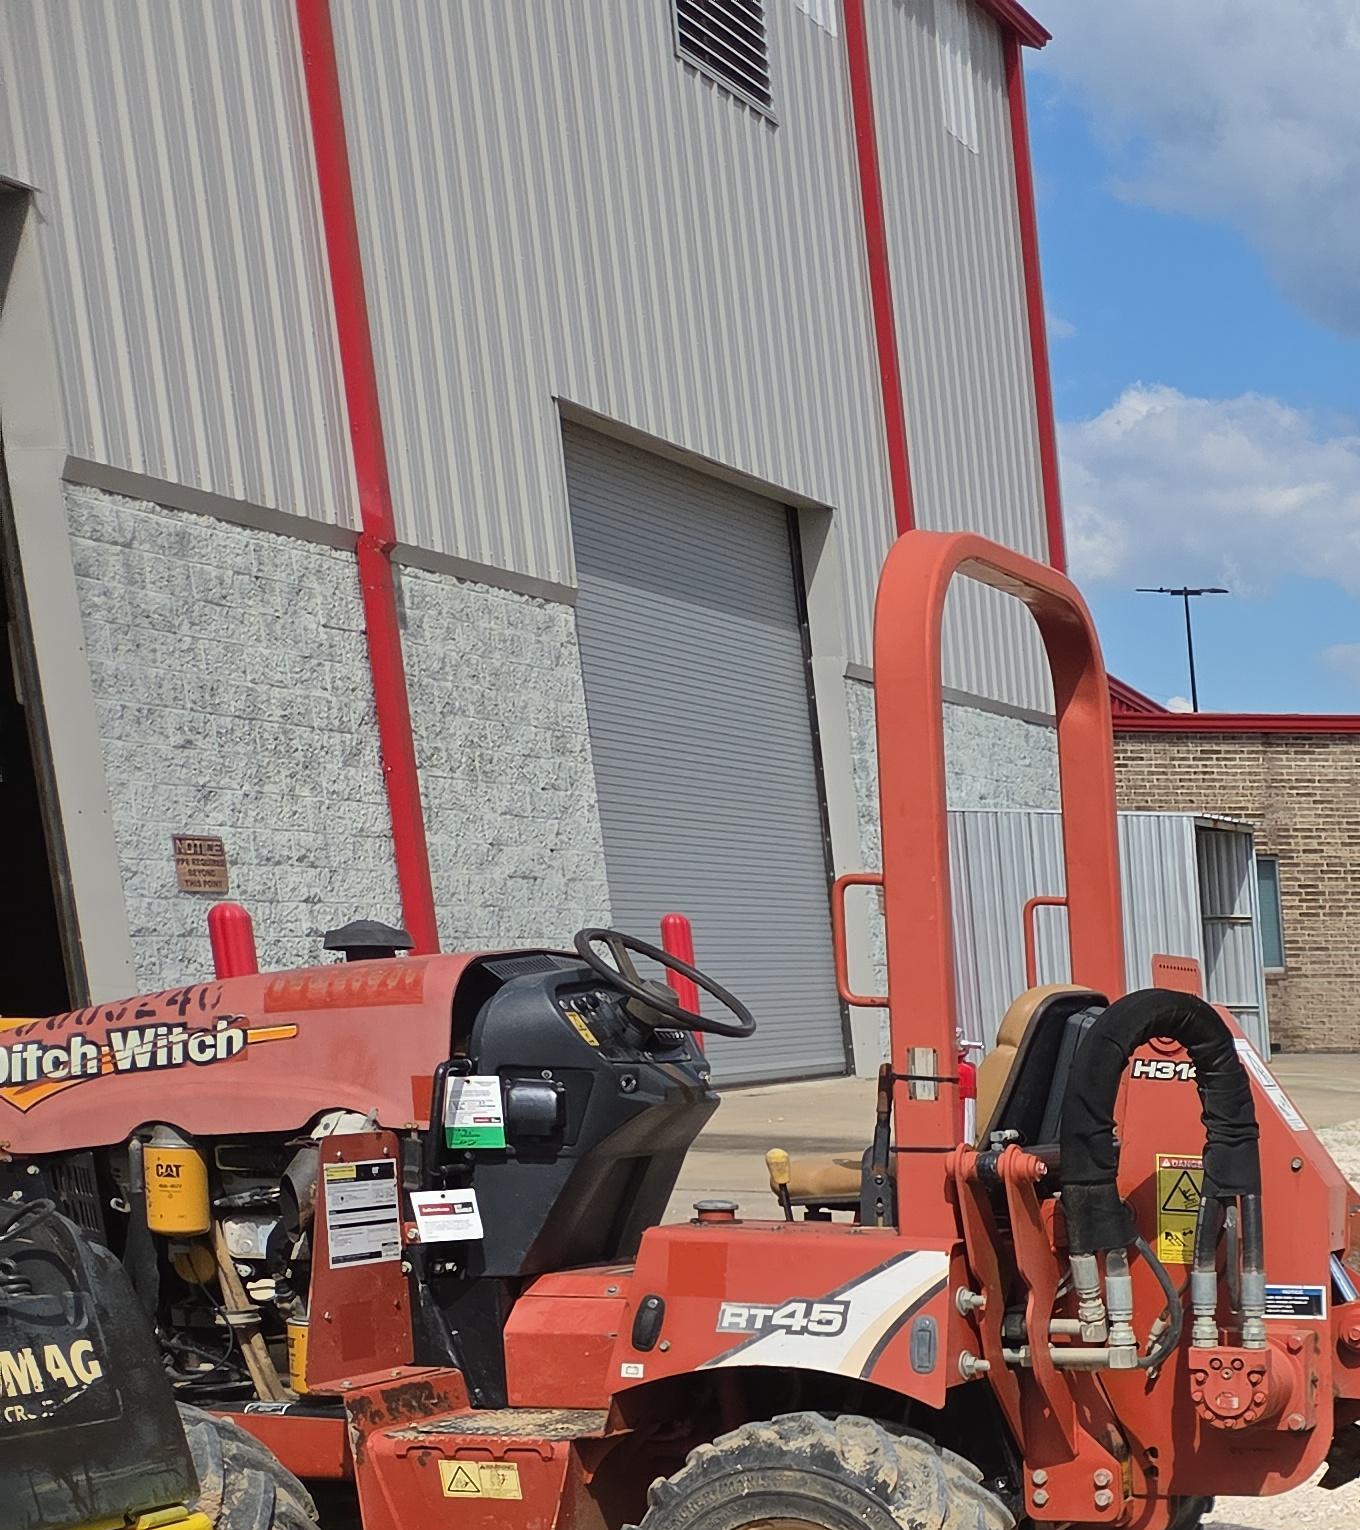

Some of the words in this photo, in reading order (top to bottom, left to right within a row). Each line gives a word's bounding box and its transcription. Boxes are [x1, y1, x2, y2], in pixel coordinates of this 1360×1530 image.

[175, 839, 221, 855] NOTICE
[110, 1020, 245, 1070] Witch
[156, 1164, 182, 1178] CAT
[1171, 1159, 1204, 1169] DANGE
[722, 1302, 845, 1333] RT45
[0, 1339, 103, 1398] MAG
